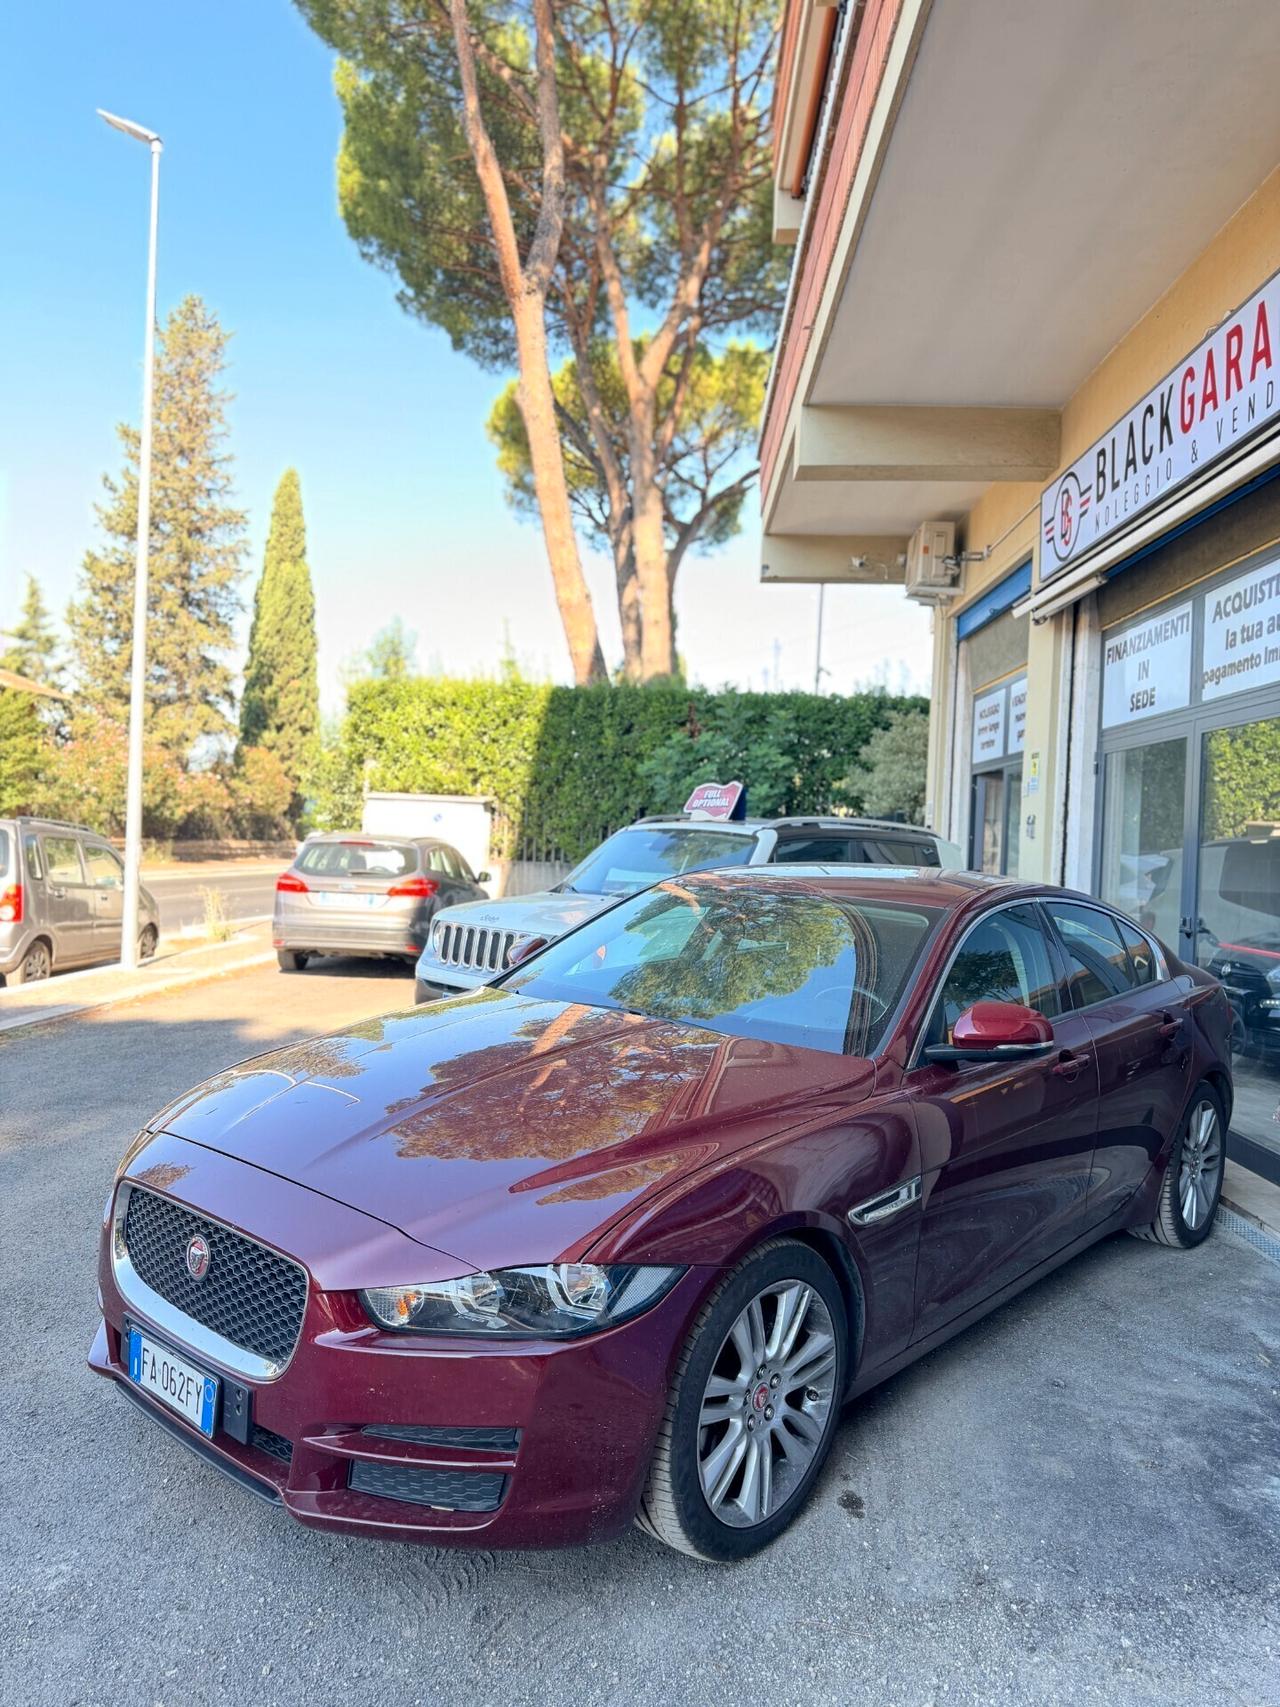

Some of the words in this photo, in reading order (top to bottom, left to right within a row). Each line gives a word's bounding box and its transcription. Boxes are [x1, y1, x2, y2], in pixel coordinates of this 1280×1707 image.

[1095, 457, 1172, 534] NOLEGGIO
[1191, 440, 1198, 463] &
[1106, 611, 1190, 666] FINANZIAMENTI
[1225, 628, 1237, 651] la
[1240, 620, 1263, 644] tua
[1137, 659, 1150, 682] IN
[1202, 653, 1261, 690] pagamento
[1129, 687, 1156, 713] SEDE
[692, 797, 730, 808] OPTIONAL
[703, 789, 721, 798] FULL
[142, 1347, 157, 1384] FA
[161, 1361, 202, 1415] 062FY
